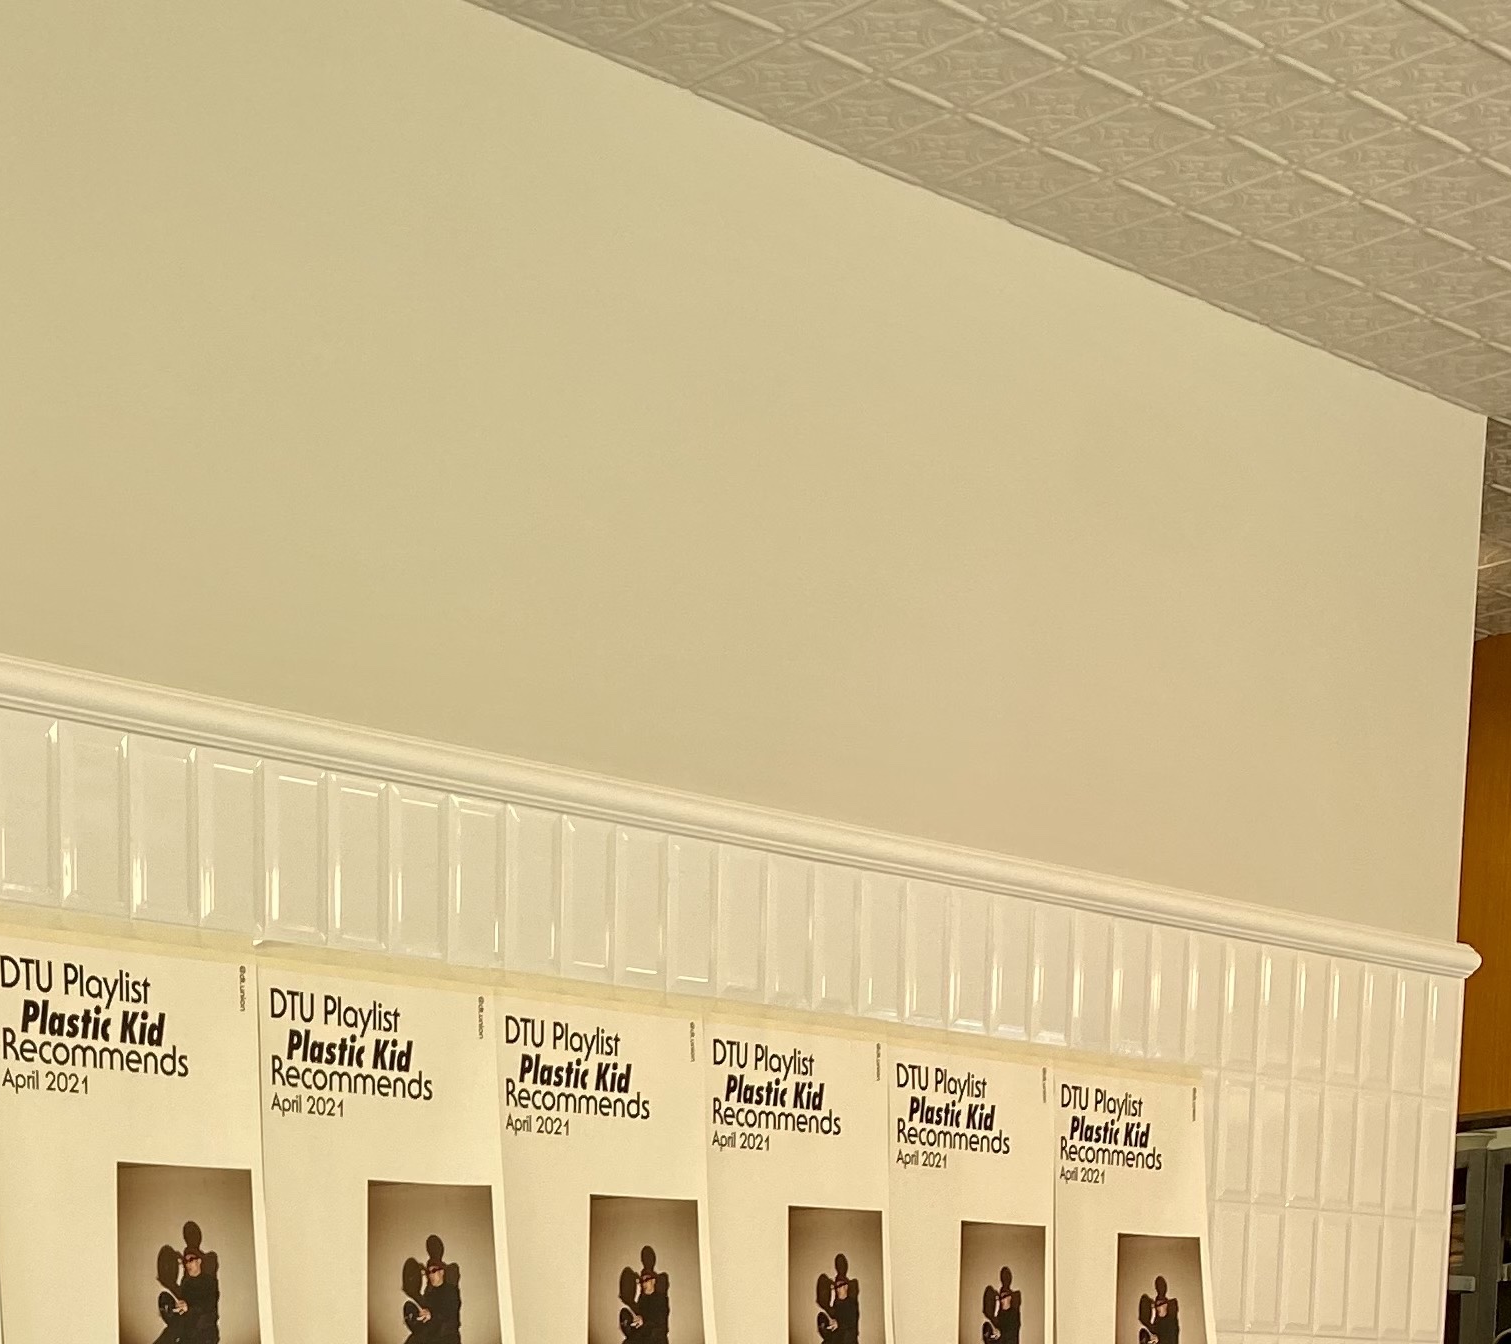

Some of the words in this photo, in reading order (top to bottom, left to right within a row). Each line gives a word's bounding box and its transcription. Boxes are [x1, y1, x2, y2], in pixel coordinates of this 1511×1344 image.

[0, 954, 53, 994] DTU
[63, 962, 151, 1010] Playlist
[20, 998, 112, 1043] Plastic
[119, 1009, 166, 1048] Kid
[269, 987, 315, 1024] DTU
[323, 994, 401, 1039] Playlist
[2, 1026, 189, 1078] Recommends
[286, 1028, 366, 1069] Plastic
[371, 1037, 414, 1073] Kid
[505, 1014, 545, 1049] DTU
[552, 1021, 621, 1062] Playlist
[271, 1054, 433, 1101] Recommends
[518, 1053, 590, 1091] Plastic
[594, 1061, 633, 1094] Kid
[712, 1038, 749, 1070] DTU
[753, 1043, 815, 1082] Playlist
[1, 1067, 40, 1095] April
[44, 1070, 88, 1095] 2021
[505, 1077, 651, 1120] Recommends
[724, 1073, 788, 1108] Plastic
[792, 1081, 825, 1112] Kid
[896, 1062, 929, 1092] DTU
[934, 1067, 988, 1104] Playlist
[270, 1092, 303, 1118] April
[306, 1095, 344, 1118] 2021
[712, 1096, 842, 1136] Recommends
[907, 1095, 962, 1129] Plastic
[965, 1103, 996, 1132] Kid
[1060, 1083, 1090, 1111] DTU
[1093, 1087, 1144, 1123] Playlist
[505, 1113, 532, 1136] April
[535, 1115, 570, 1136] 2021
[711, 1129, 737, 1152] April
[739, 1131, 770, 1152] 2021
[896, 1117, 1011, 1155] Recommends
[1069, 1115, 1121, 1146] Plastic
[1122, 1121, 1151, 1149] Kid
[895, 1148, 920, 1170] April
[921, 1150, 947, 1169] 2021
[1059, 1135, 1163, 1171] Recommends
[1059, 1165, 1080, 1184] April
[1080, 1166, 1106, 1185] 2021
